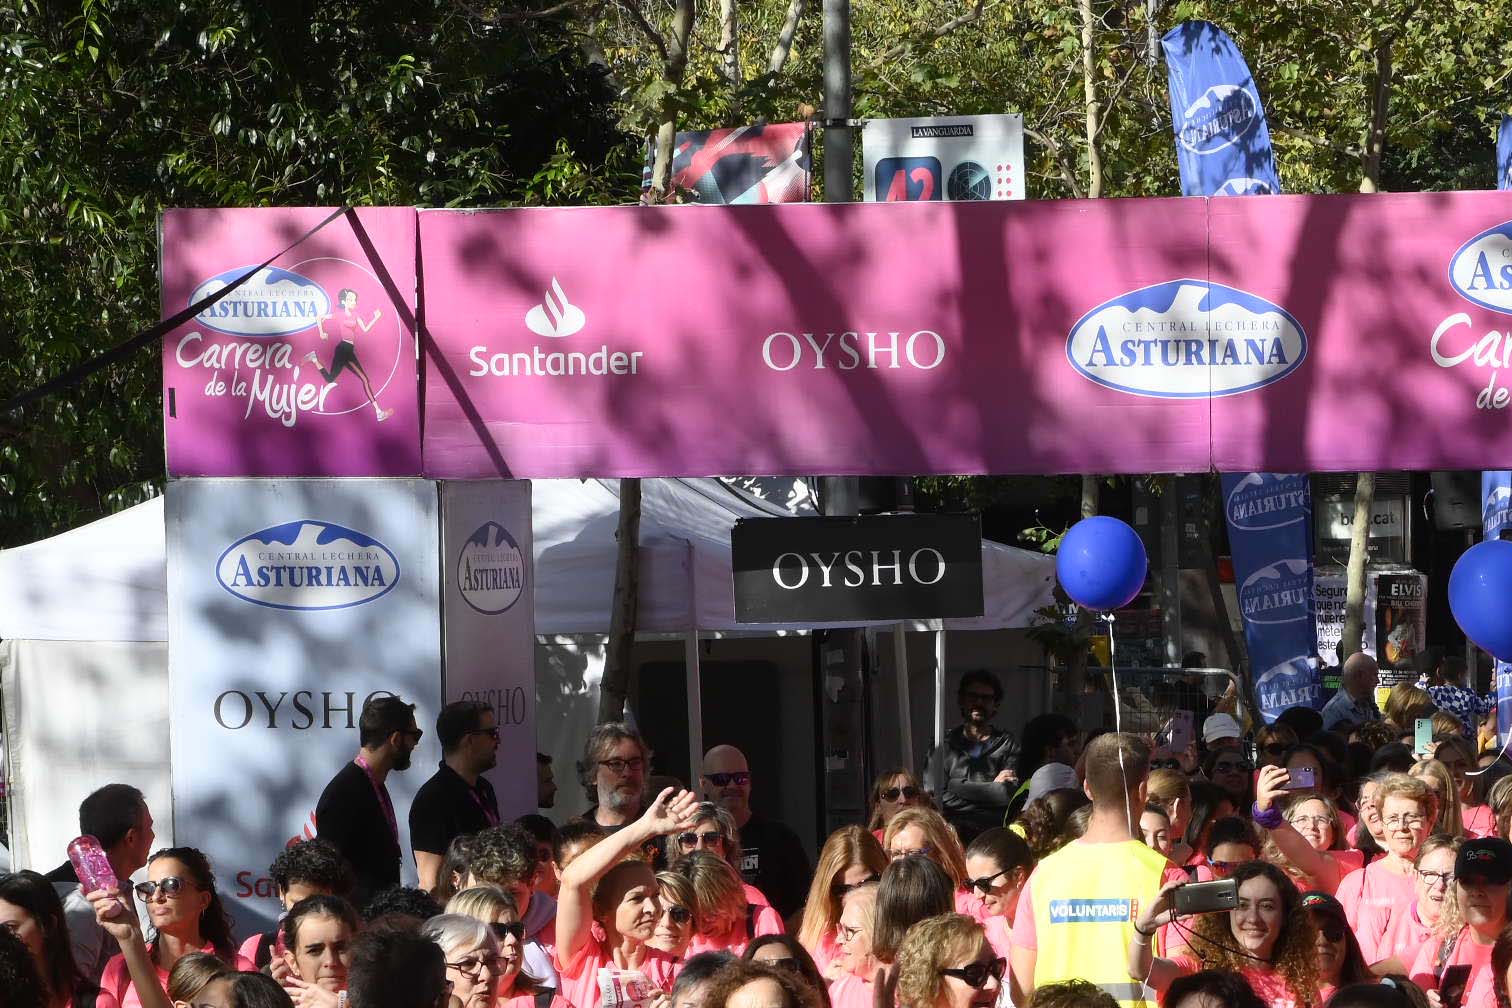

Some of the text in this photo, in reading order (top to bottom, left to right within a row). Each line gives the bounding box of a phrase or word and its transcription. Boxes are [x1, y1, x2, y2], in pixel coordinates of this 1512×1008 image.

[1122, 319, 1281, 332] CENTRAL LECHERA
[175, 332, 293, 369] Carrera
[468, 345, 644, 377] Santander
[761, 330, 947, 372] OYSHO
[1085, 324, 1288, 368] ASTURIANA
[204, 367, 338, 428] de la Mujer
[1476, 371, 1511, 410] de
[230, 554, 387, 588] ASTURIANA
[258, 551, 380, 561] CENTRAL LECHERA
[463, 554, 521, 593] ASTURIANA
[772, 547, 946, 590] OYSHO
[1390, 583, 1422, 596] ELVIS
[1316, 612, 1346, 624] quiere
[1051, 903, 1128, 918] VOLUNTARIS
